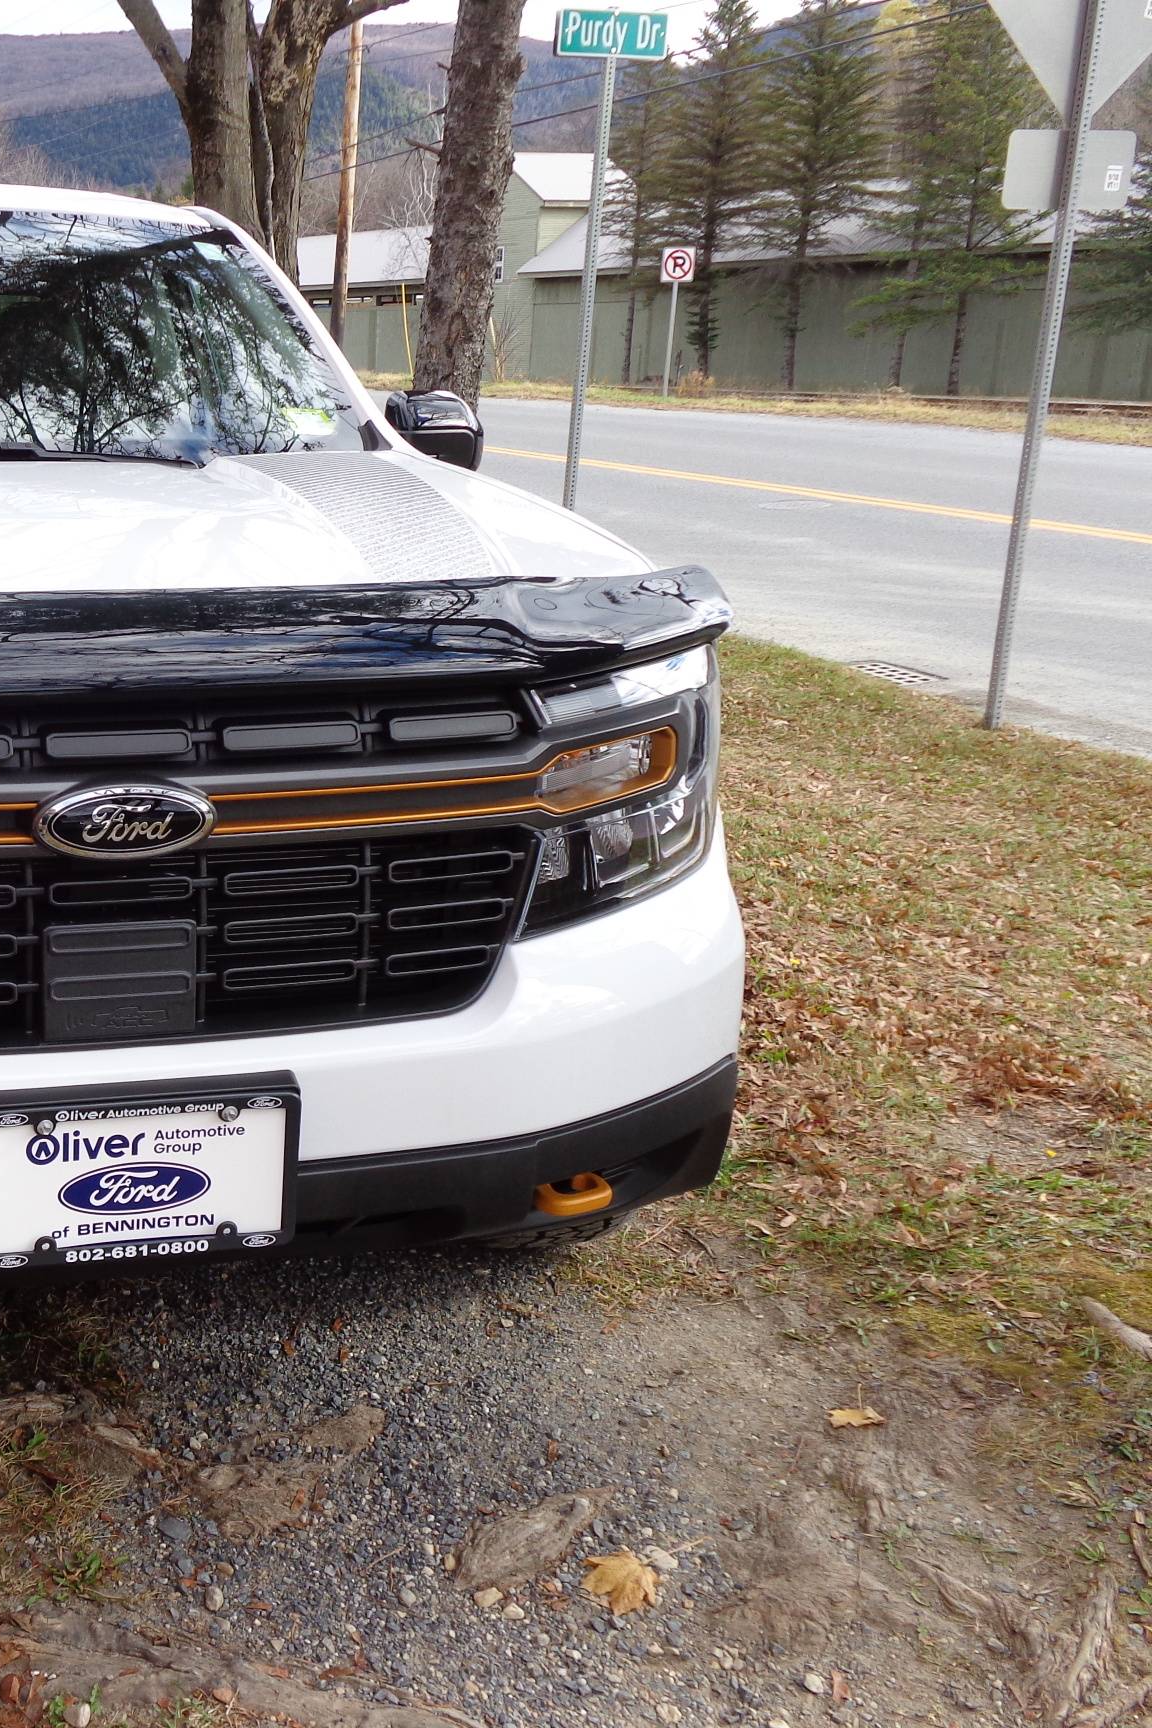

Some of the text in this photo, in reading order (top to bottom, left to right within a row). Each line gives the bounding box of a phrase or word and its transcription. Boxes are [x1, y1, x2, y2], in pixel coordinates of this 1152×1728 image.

[566, 11, 661, 53] Purdy Dr
[82, 804, 175, 843] Ford
[55, 1102, 224, 1122] Oliver Automotive Group
[25, 1124, 245, 1165] Oliver Automotive
[153, 1140, 202, 1155] Group
[89, 1170, 180, 1206] Ford
[52, 1214, 215, 1239] of BENNINGTON
[65, 1239, 209, 1263] 802-681-0800
